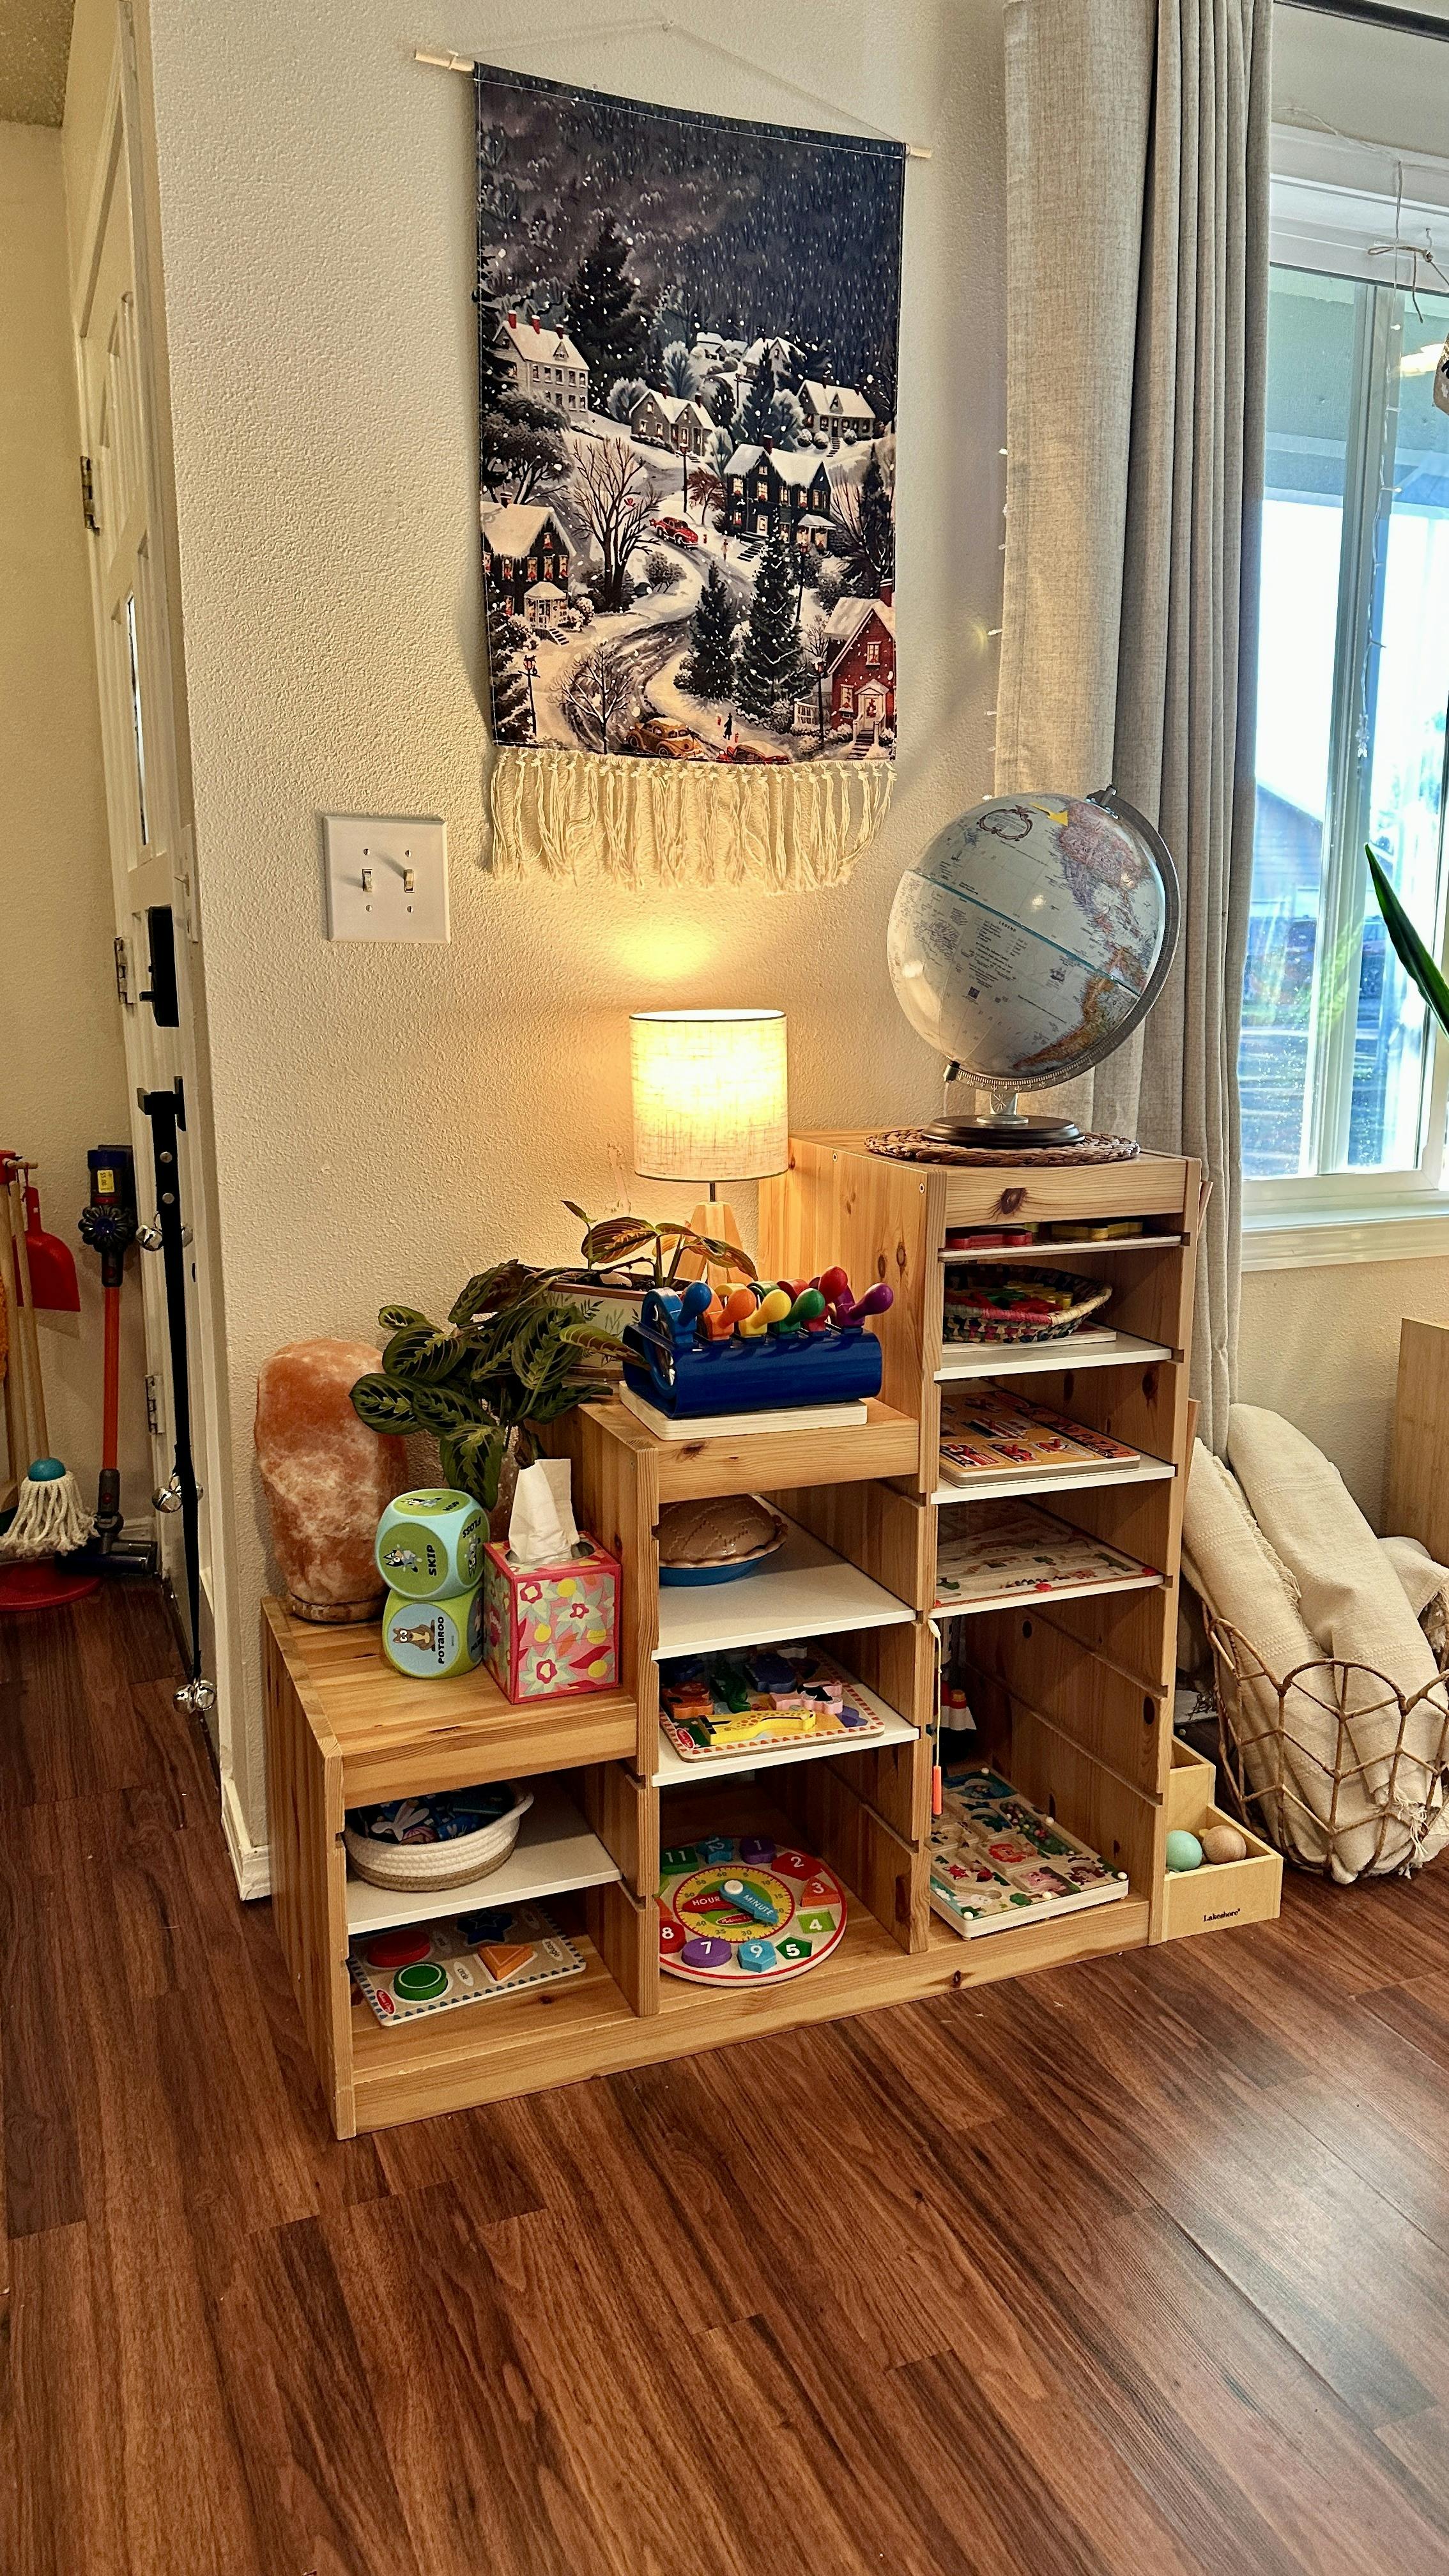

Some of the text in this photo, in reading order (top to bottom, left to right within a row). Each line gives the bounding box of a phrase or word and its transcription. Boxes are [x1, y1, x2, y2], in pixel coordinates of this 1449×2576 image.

[443, 1501, 459, 1511] HOP
[463, 1516, 481, 1538] FLOSS
[426, 1544, 437, 1576] SKIP
[705, 1837, 724, 1852] 12
[754, 1840, 762, 1851] 1
[665, 1850, 686, 1863] 11
[790, 1856, 805, 1868] 2
[811, 1882, 825, 1894] 3
[692, 1896, 721, 1906] HOUR
[743, 1894, 774, 1916] MINUTE
[809, 1919, 823, 1931] 4
[661, 1927, 675, 1940] 8
[700, 1941, 712, 1955] 7
[786, 1943, 801, 1957] 5
[457, 1968, 469, 1981] circle
